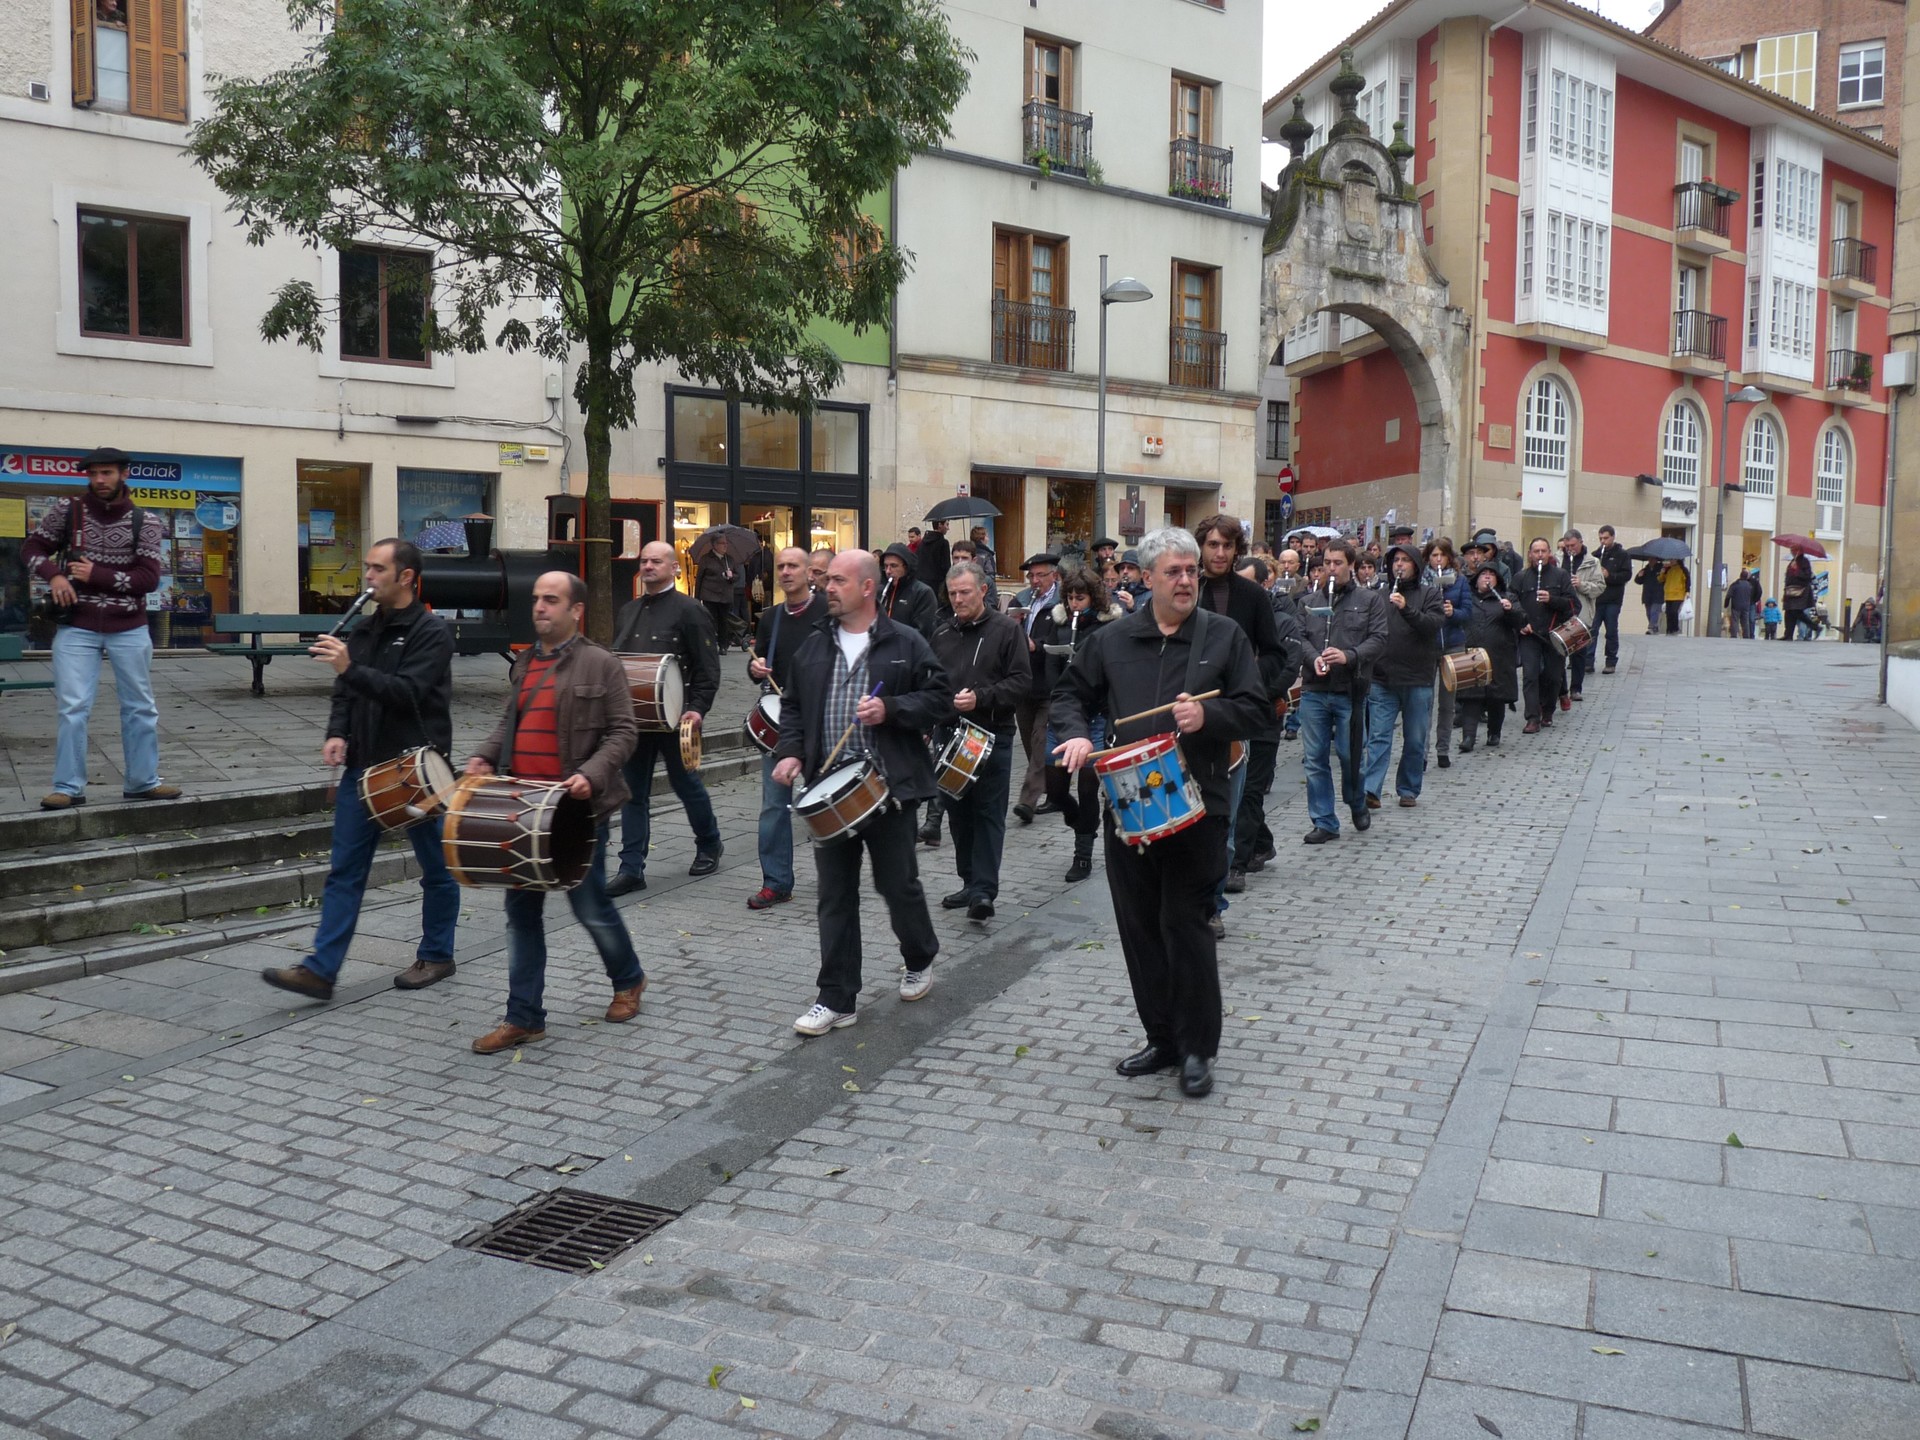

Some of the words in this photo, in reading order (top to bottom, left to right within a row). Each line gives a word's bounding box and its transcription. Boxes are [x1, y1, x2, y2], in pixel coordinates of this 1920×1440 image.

[31, 458, 87, 474] EROS
[127, 462, 178, 479] idaiak
[129, 487, 191, 501] MSERSO
